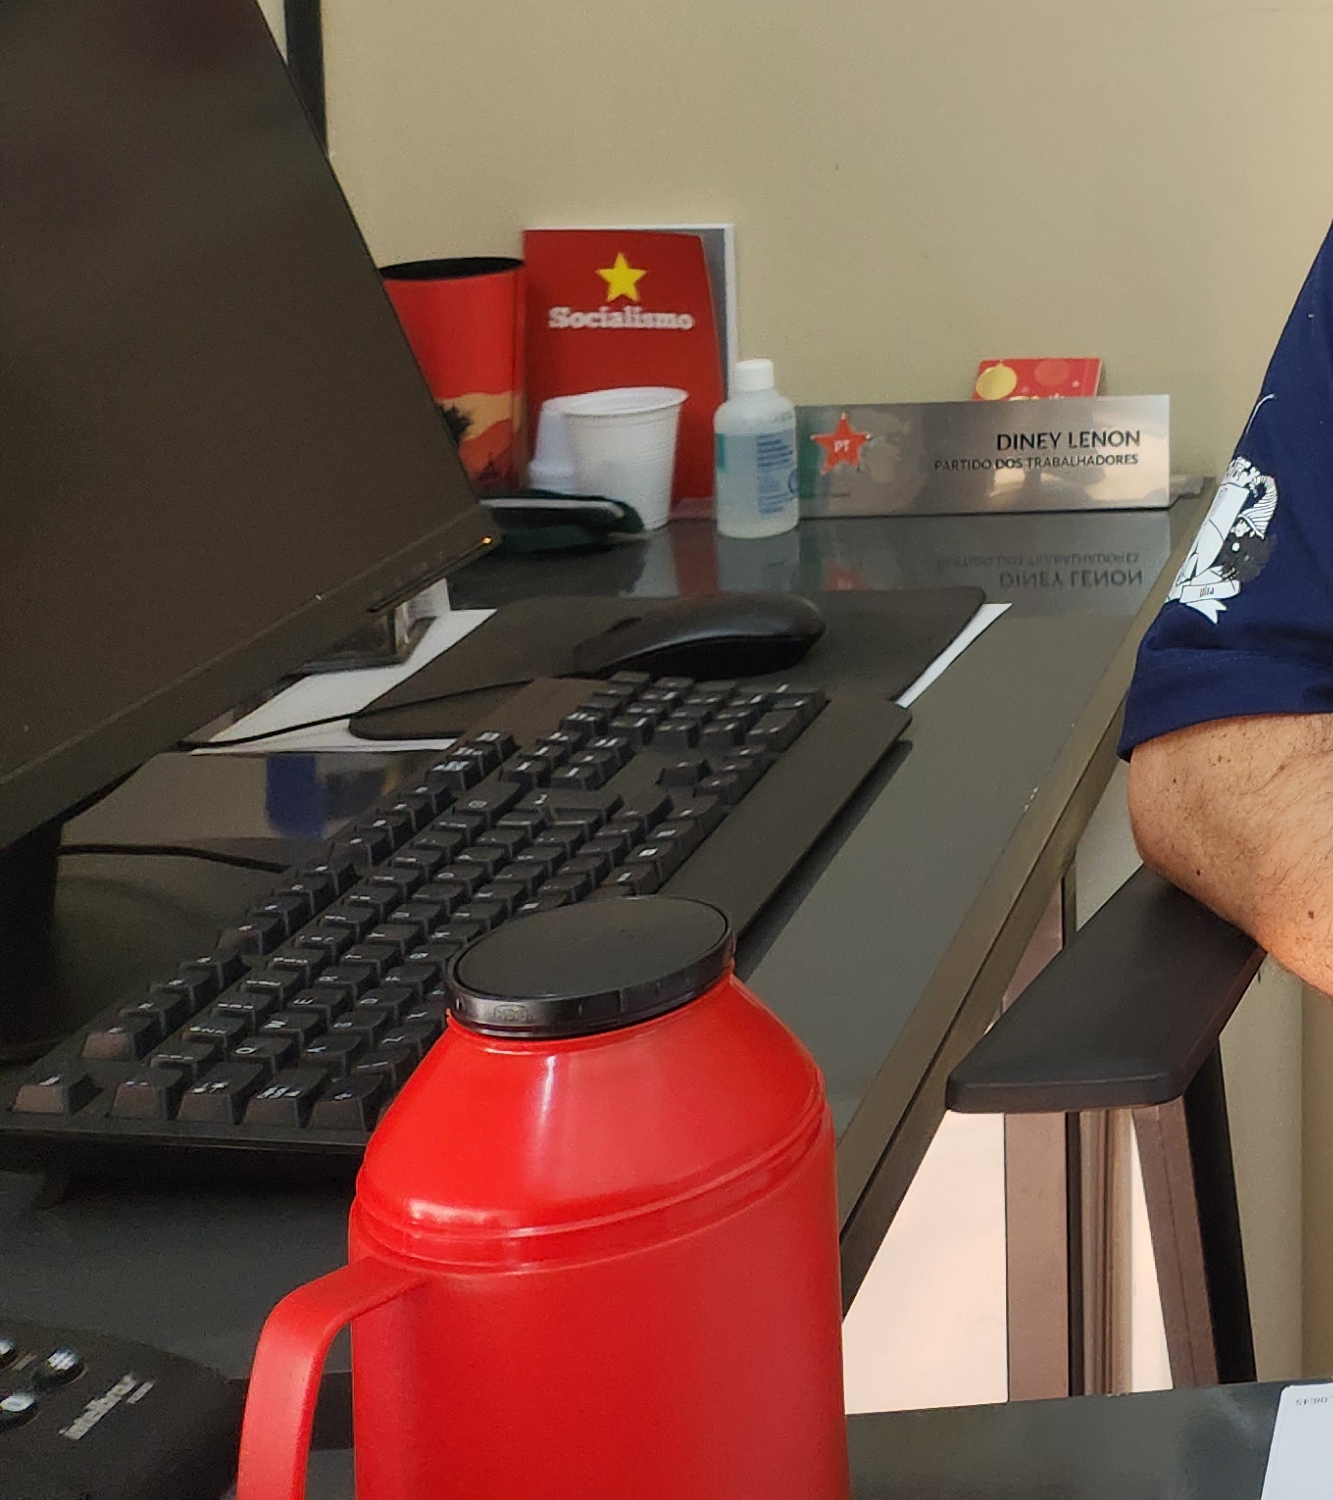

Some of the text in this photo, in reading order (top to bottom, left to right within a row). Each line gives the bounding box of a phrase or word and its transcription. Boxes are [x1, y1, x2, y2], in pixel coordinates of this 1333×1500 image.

[549, 305, 695, 330] Socialismo
[996, 429, 1141, 451] DINEY LENON
[934, 453, 1139, 471] PARTIDO DOS TRABALHADORES
